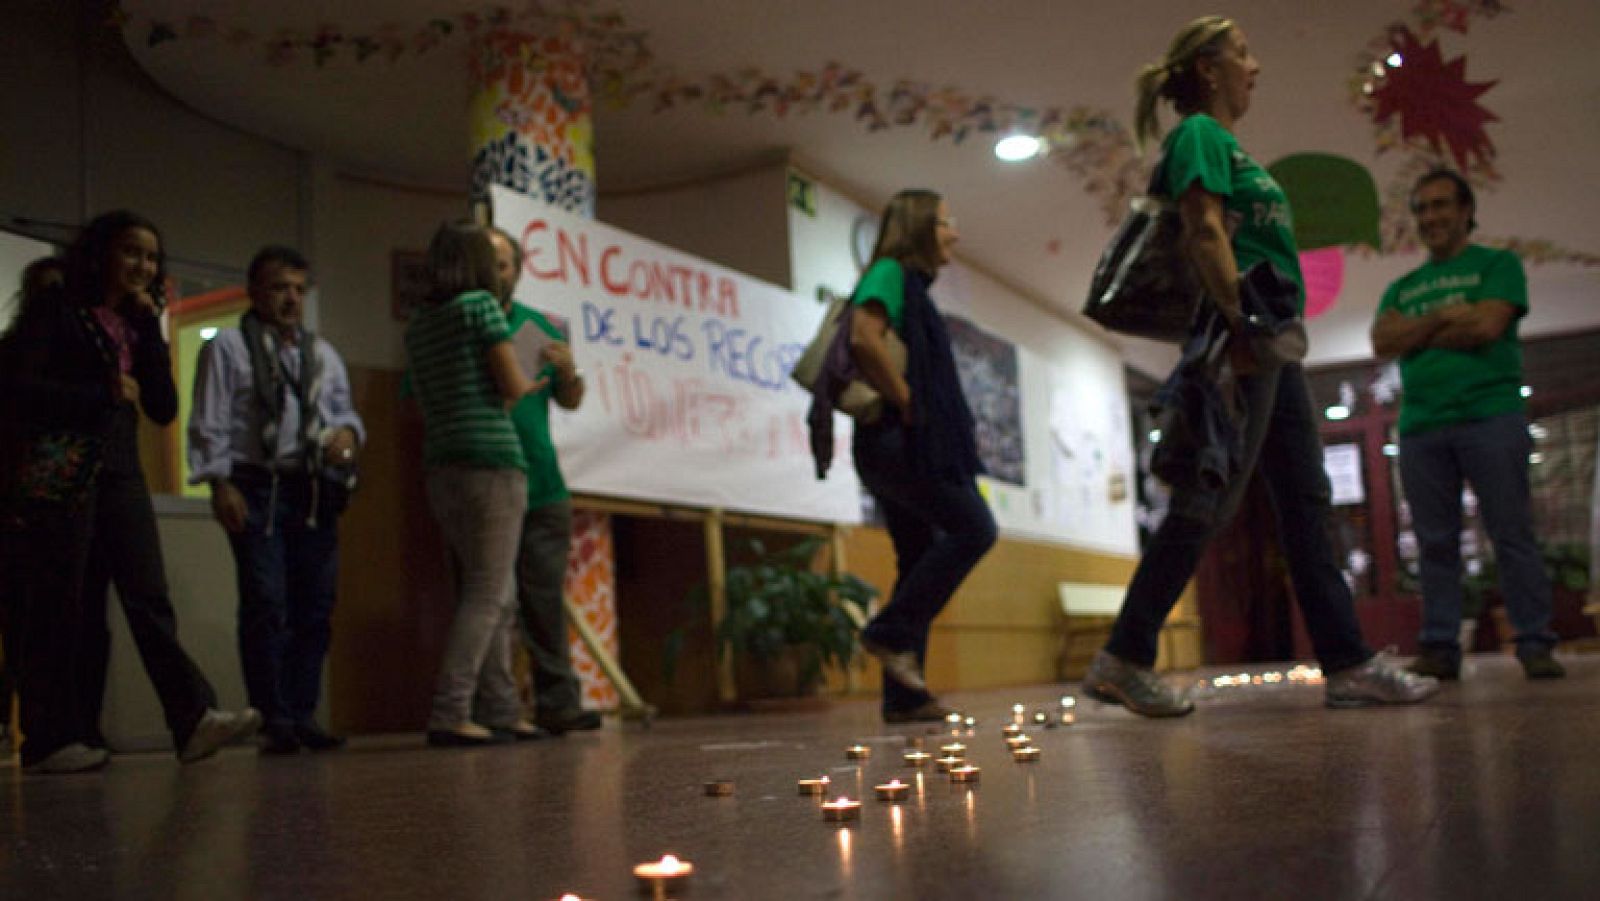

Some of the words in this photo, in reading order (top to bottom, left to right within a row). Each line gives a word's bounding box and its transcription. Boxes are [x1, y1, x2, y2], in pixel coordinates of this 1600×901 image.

[522, 219, 589, 287] EN
[600, 245, 738, 317] CONTRA
[582, 301, 624, 345] DE
[633, 313, 694, 360] LOS
